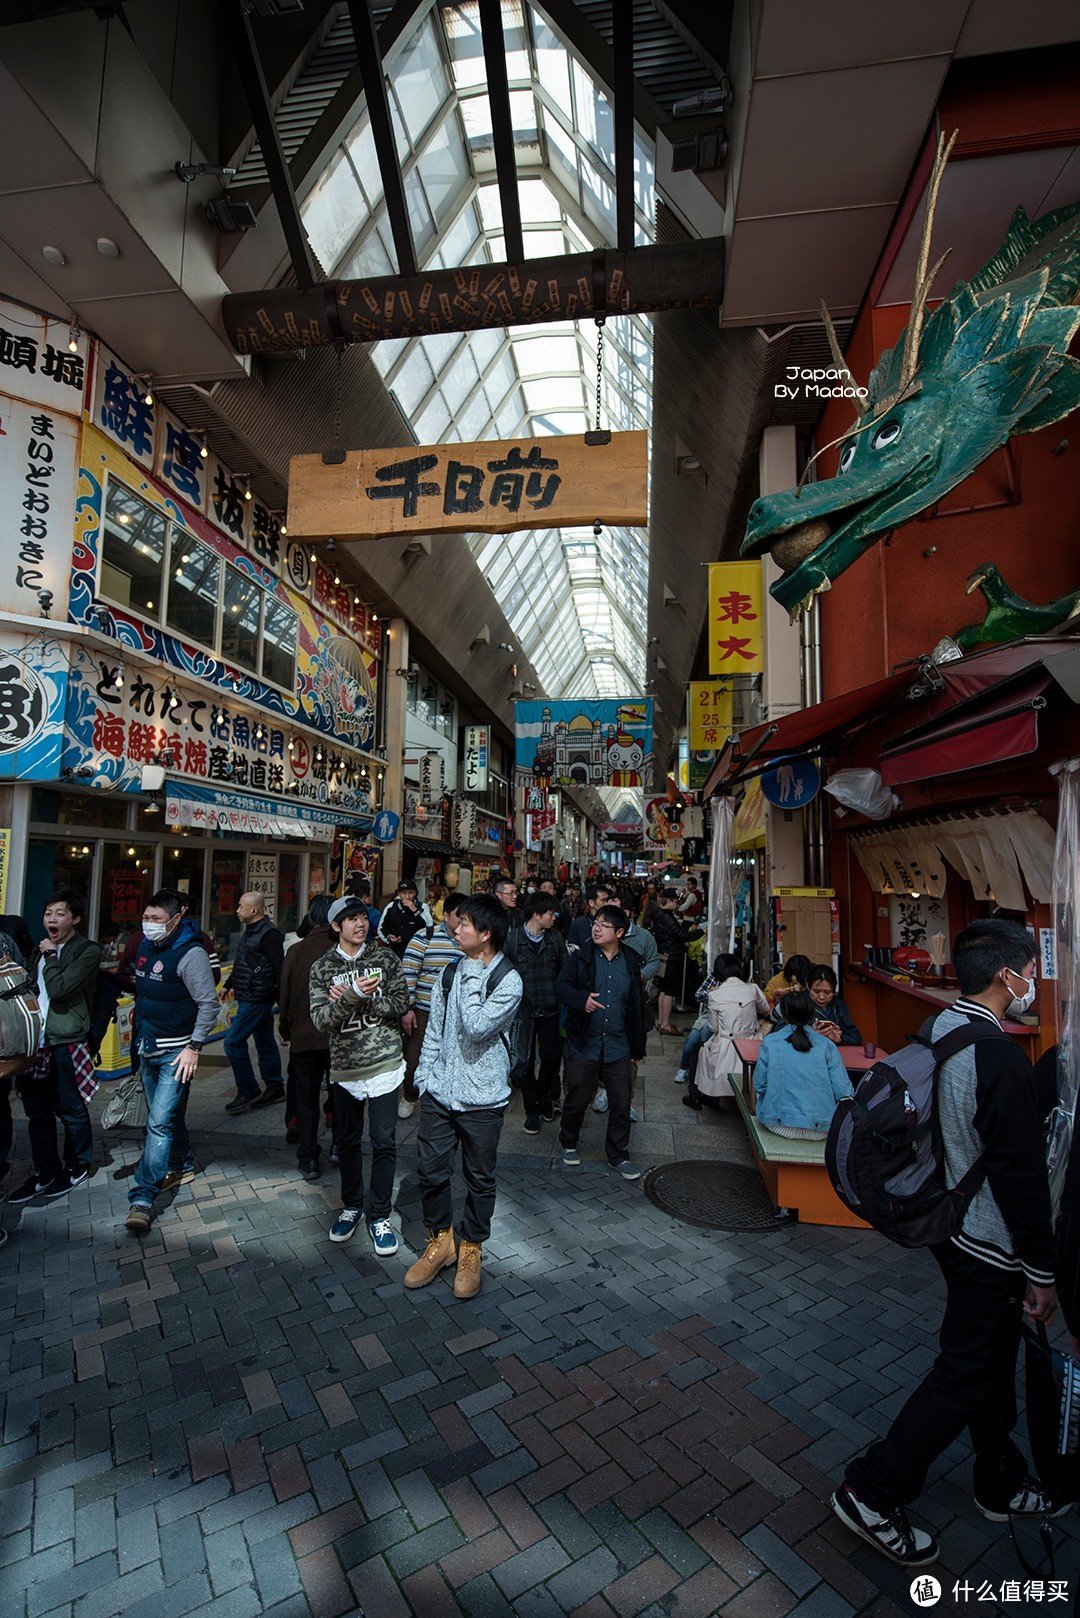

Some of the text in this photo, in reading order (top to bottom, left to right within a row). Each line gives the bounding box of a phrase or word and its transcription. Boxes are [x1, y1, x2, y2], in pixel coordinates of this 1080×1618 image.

[0, 327, 85, 391] 頓堀
[101, 360, 282, 568] 鮮度抜群
[365, 446, 562, 518] 千日前
[15, 412, 55, 591] まいどおおきに
[716, 591, 758, 661] 東大
[97, 661, 207, 732] とれたて
[700, 690, 721, 706] 2F
[702, 714, 719, 726] 25
[92, 708, 207, 777] 海鮮浜焼
[466, 747, 479, 789] たよし
